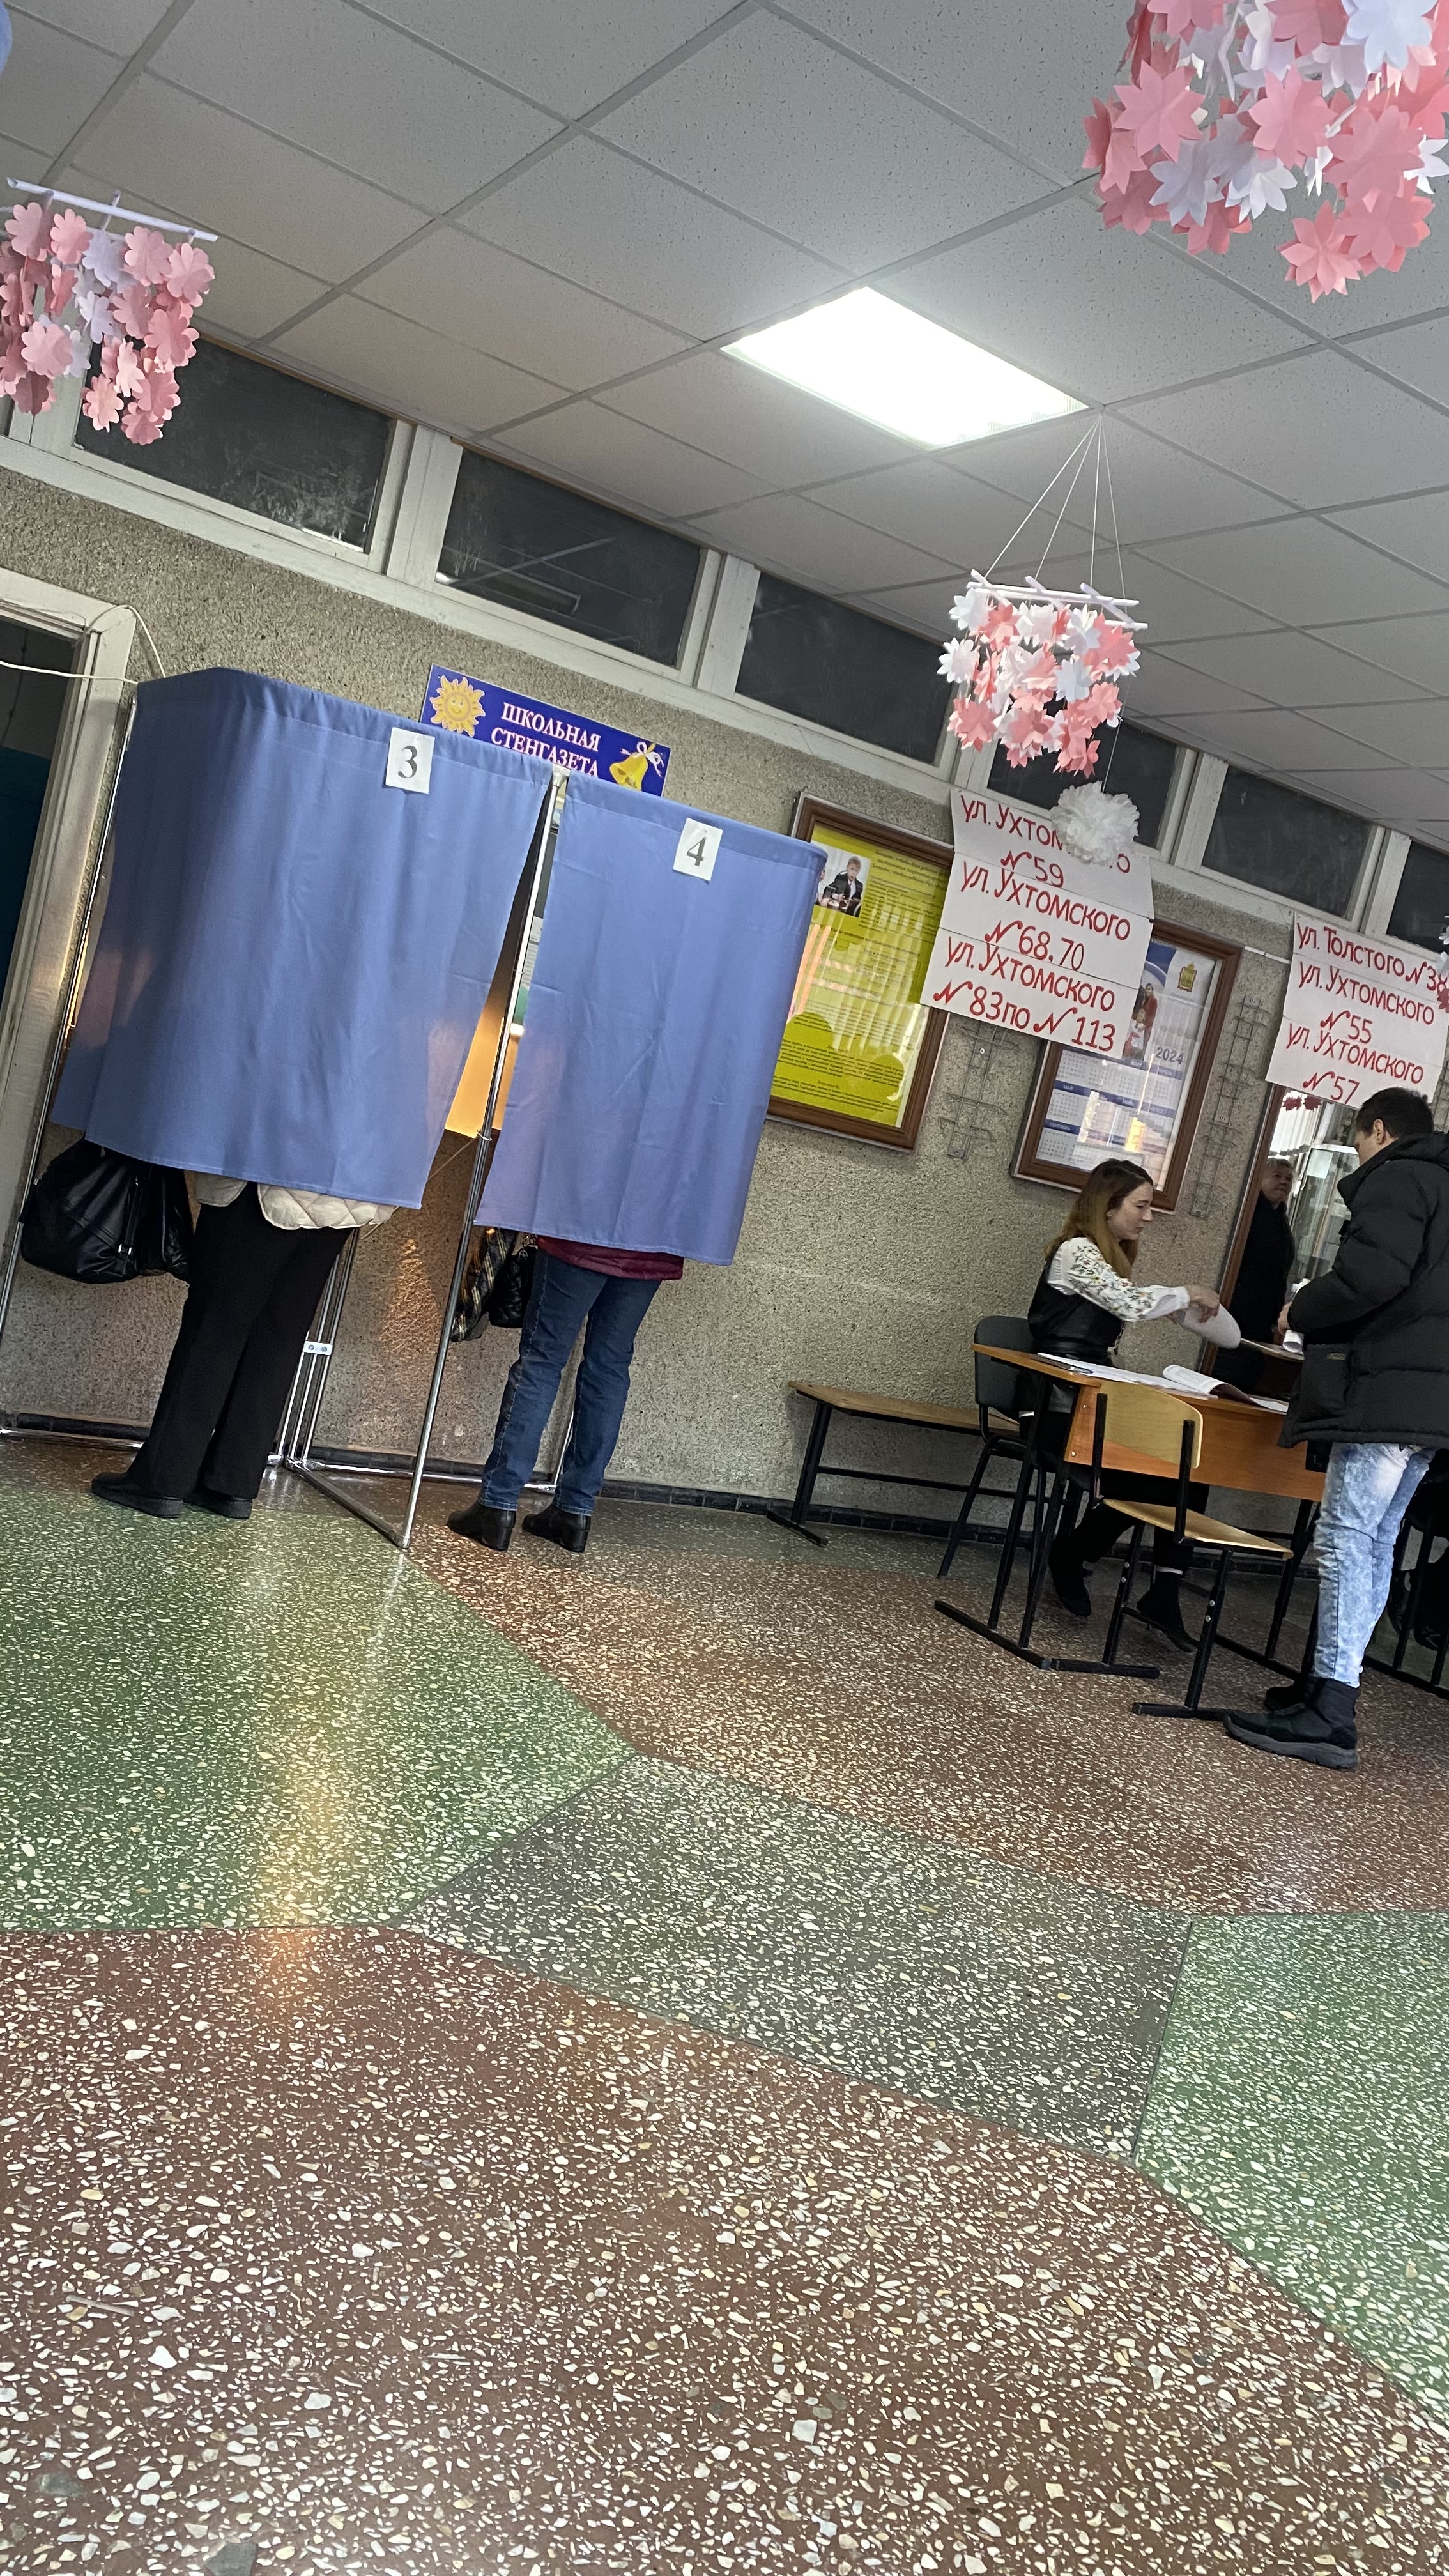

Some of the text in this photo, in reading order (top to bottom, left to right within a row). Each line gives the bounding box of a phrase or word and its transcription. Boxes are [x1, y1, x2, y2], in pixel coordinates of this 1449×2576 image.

[501, 702, 601, 752] ШКОЛЬНАЯ
[398, 745, 418, 779] 3
[491, 728, 599, 778] СТЕНГАЗЕТА
[686, 837, 707, 867] 4
[1156, 1046, 1184, 1064] 2024
